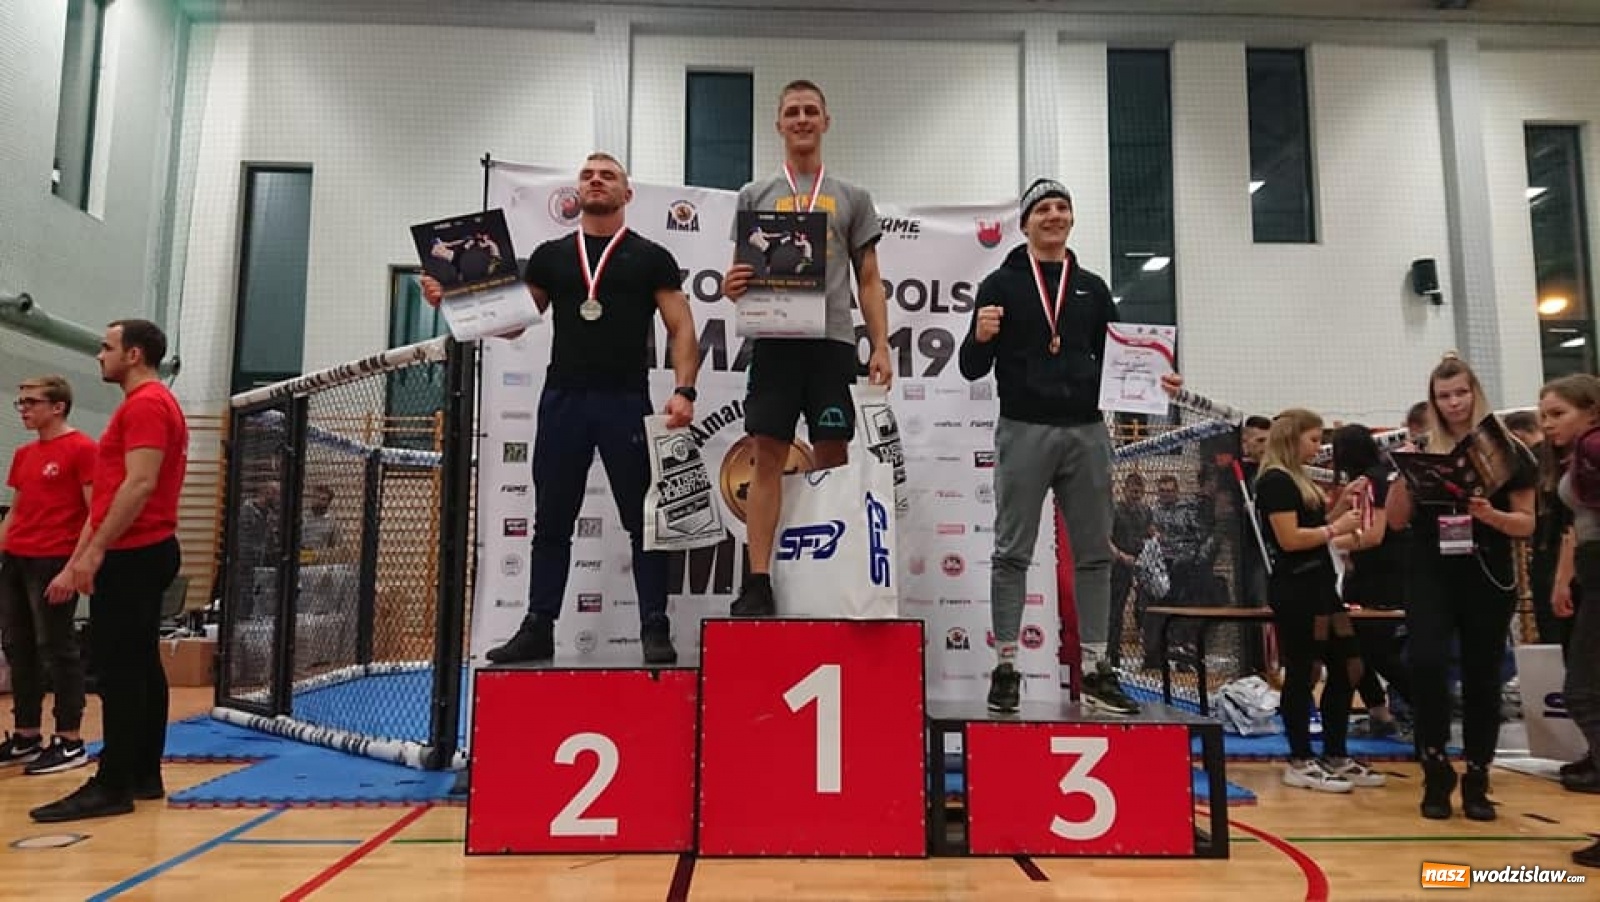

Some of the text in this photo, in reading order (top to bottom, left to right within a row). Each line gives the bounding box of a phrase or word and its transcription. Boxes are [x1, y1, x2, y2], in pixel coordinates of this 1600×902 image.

[855, 326, 955, 378] 019
[688, 399, 747, 448] Amat
[782, 664, 842, 794] 1
[550, 731, 620, 837] 2
[1050, 736, 1117, 840] 3
